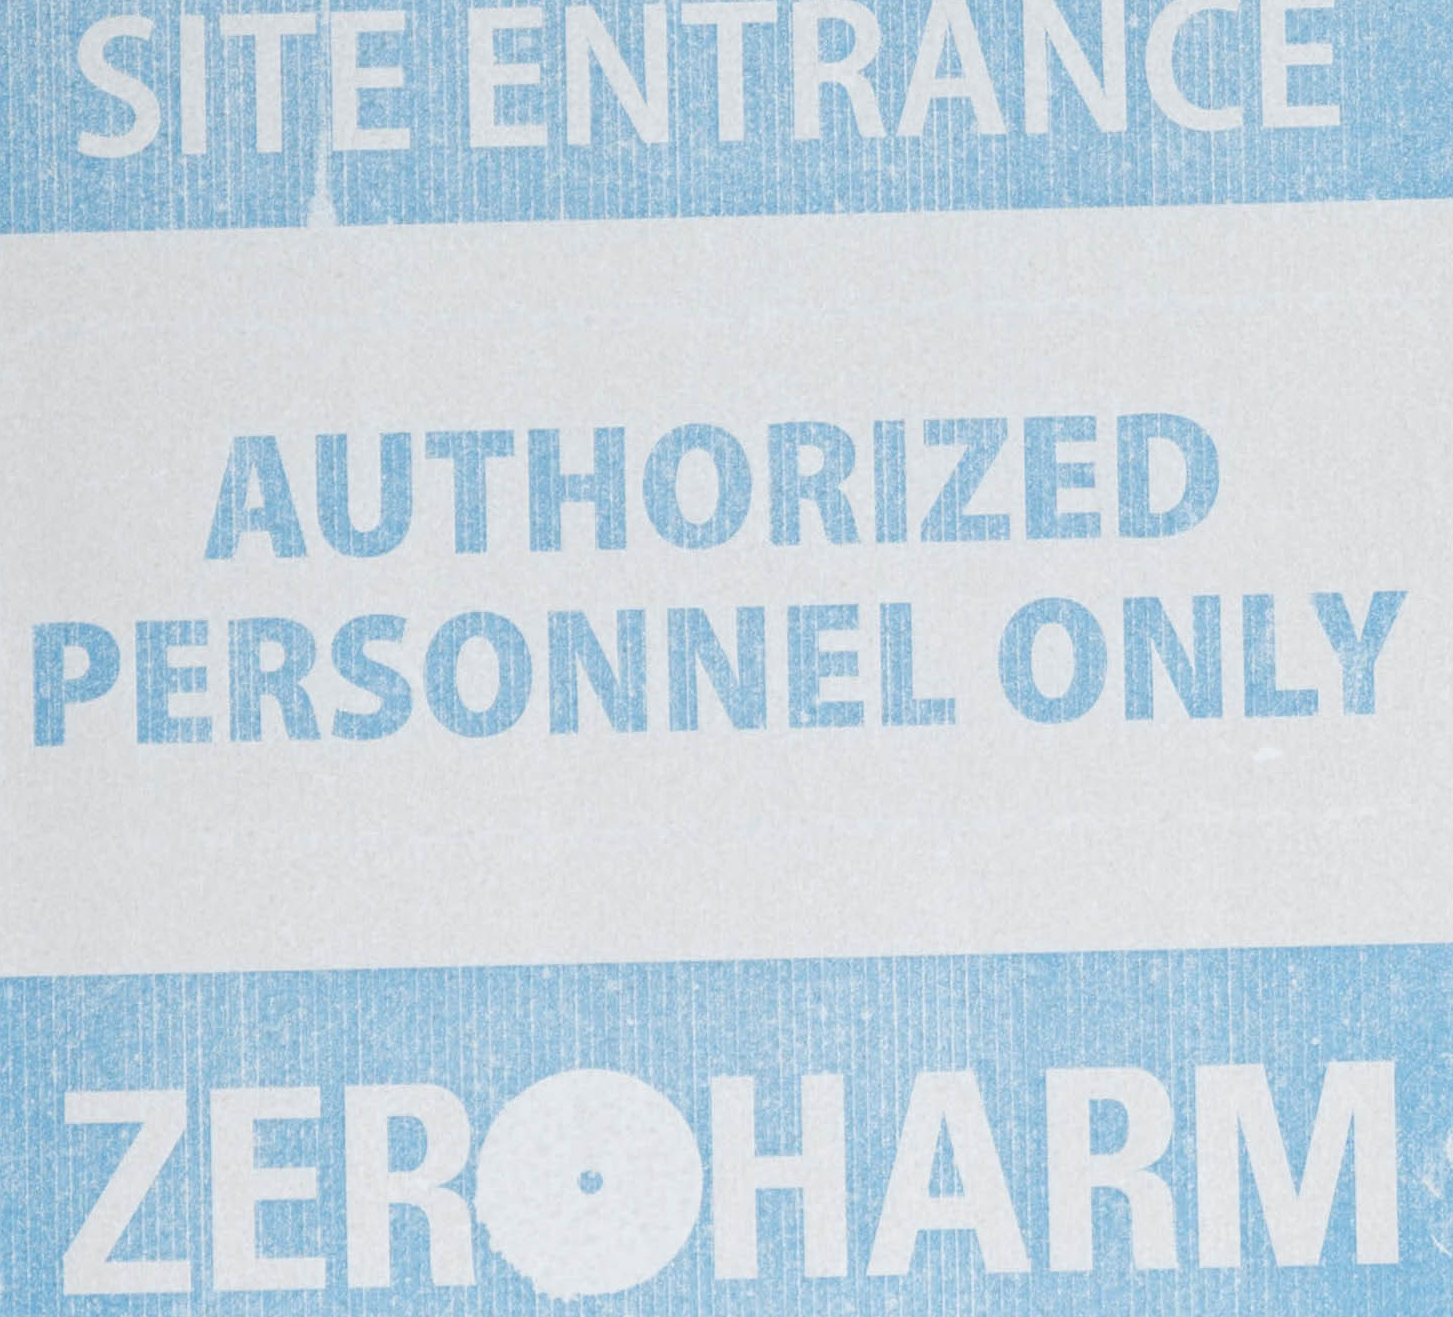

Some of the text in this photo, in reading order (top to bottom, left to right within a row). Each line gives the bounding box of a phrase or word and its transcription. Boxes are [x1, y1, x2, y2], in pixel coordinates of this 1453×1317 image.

[75, 8, 413, 159] SITE
[203, 412, 1221, 560] AUTHORIZED
[31, 589, 1409, 748] PERSONNEL ONLY
